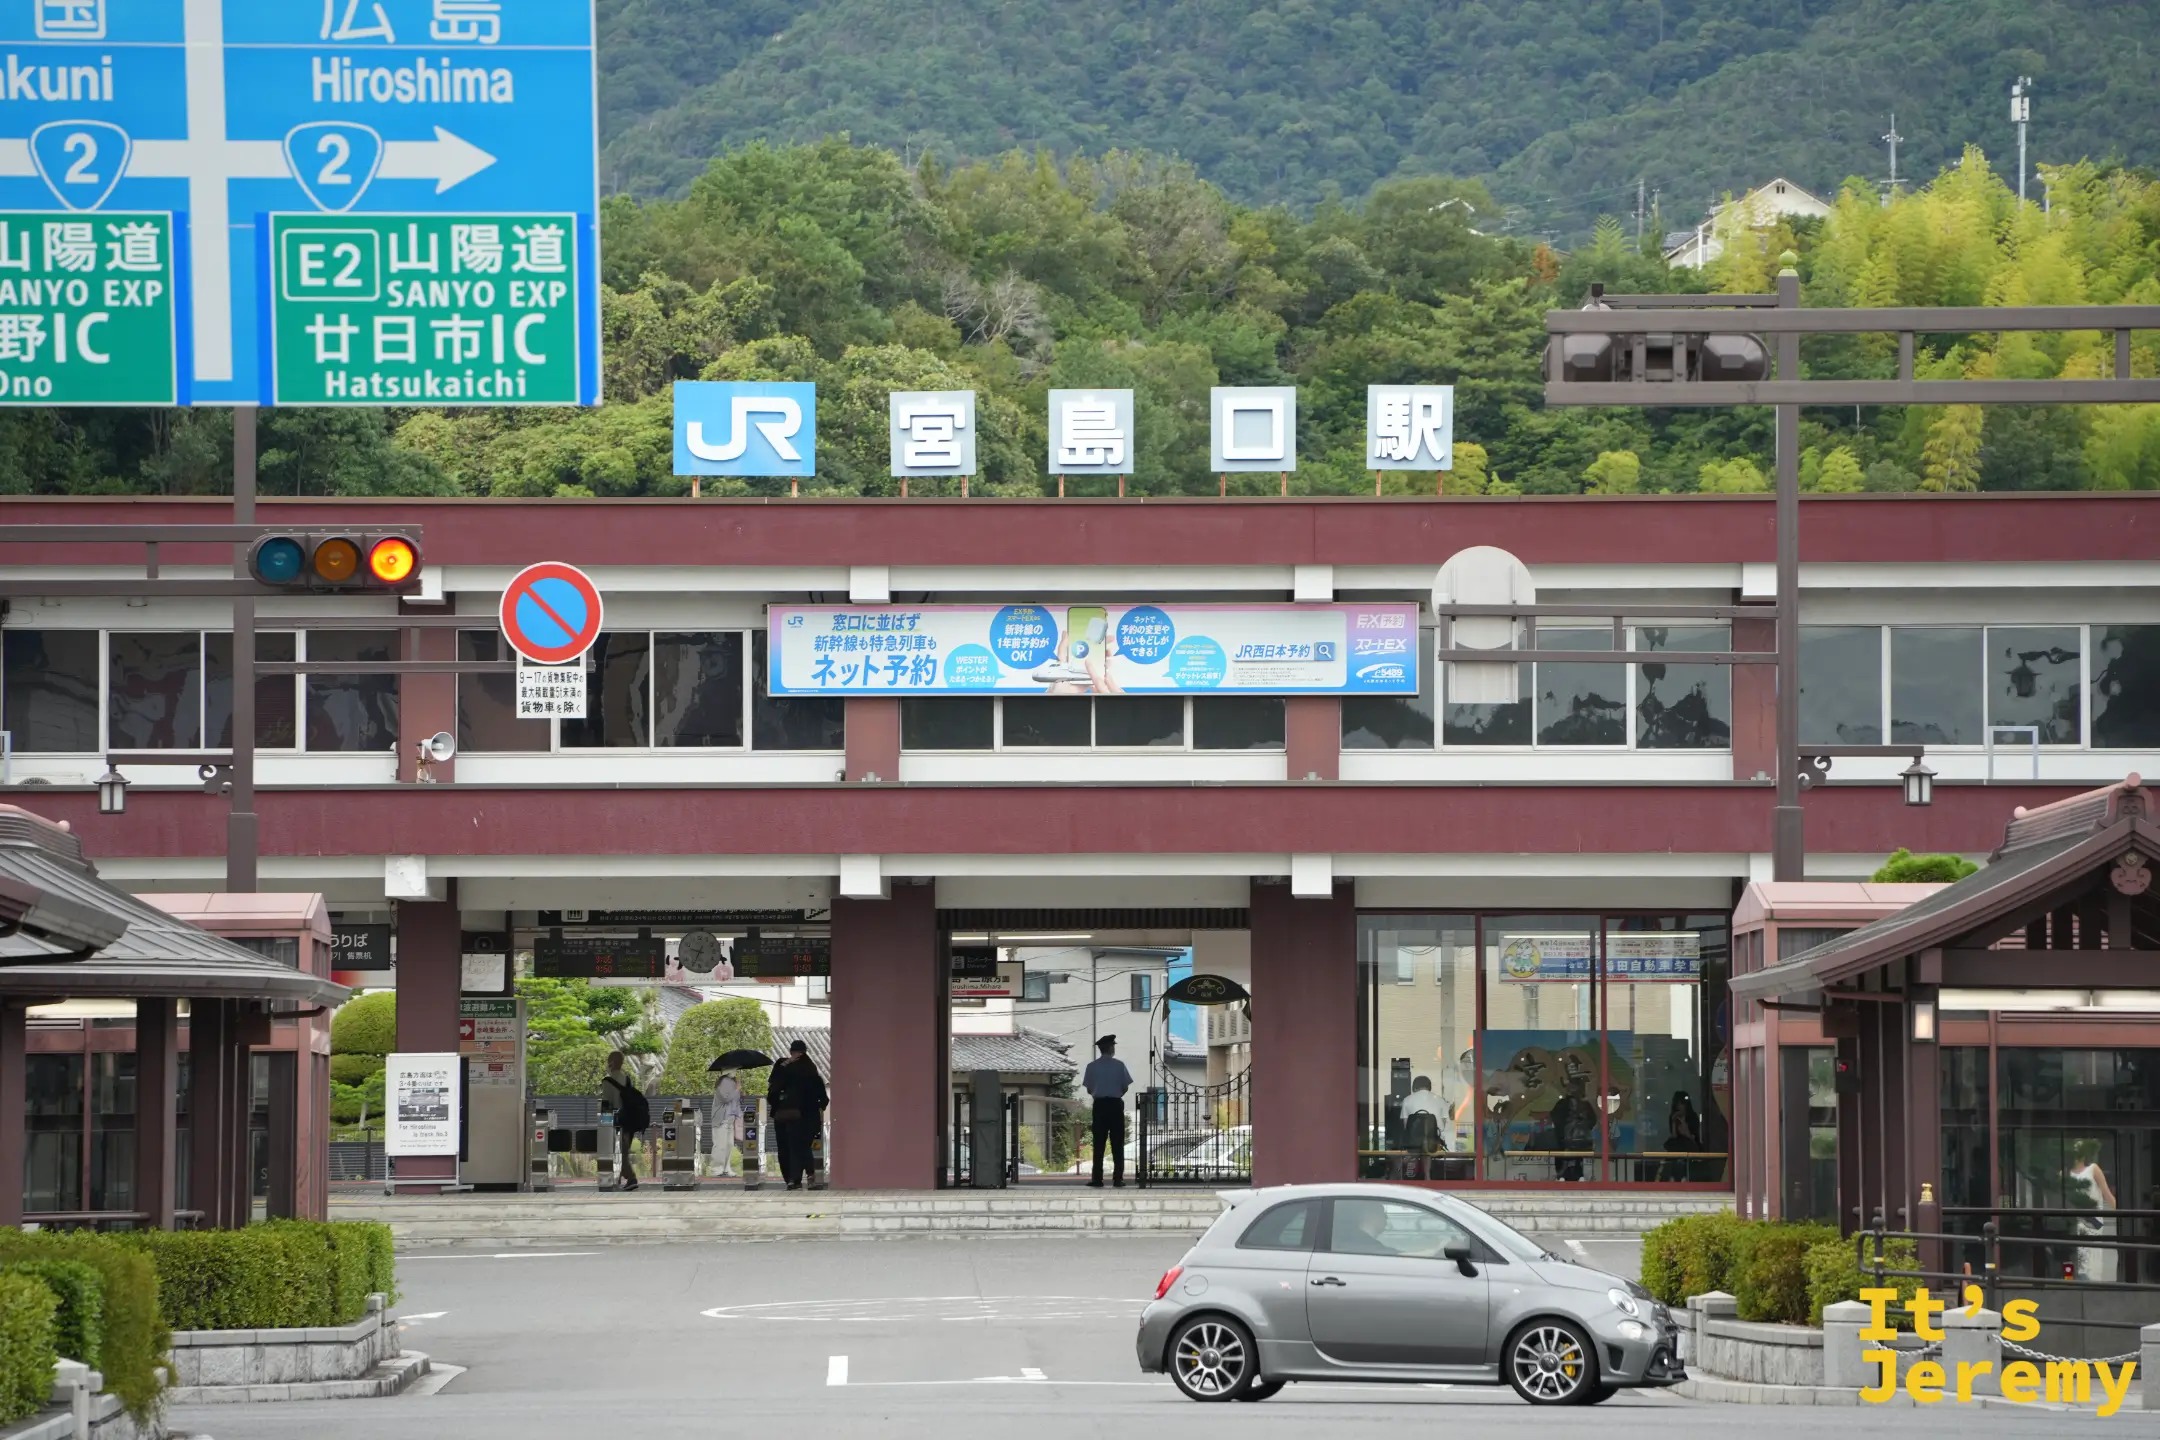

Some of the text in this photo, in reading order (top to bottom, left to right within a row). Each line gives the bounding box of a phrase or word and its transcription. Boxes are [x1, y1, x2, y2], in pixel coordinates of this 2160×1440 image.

[319, 0, 502, 44] 広島
[0, 54, 114, 102] kuni
[311, 56, 514, 103] Hiroshima
[64, 132, 99, 184] 2
[317, 133, 352, 185] 2
[0, 221, 163, 272] 山陽道
[388, 223, 568, 273] 山陽道
[299, 241, 363, 288] E2
[104, 279, 163, 307] EXP
[387, 280, 568, 308] SANYO EXP
[305, 313, 547, 365] 廿日市IC
[325, 369, 527, 398] Hatsukaichi
[686, 393, 1446, 468] JR 宮島口駅
[787, 616, 803, 626] JR
[832, 613, 921, 631] 窓口に並ばず
[1005, 624, 1044, 636] 新幹線の
[1121, 625, 1170, 635] 予約の変更や
[1134, 616, 1156, 624] ネットで
[1356, 613, 1406, 629] EX予約
[814, 635, 937, 653] 新幹線も特急列車も
[997, 637, 1050, 649] 1年前予約が
[1122, 636, 1169, 646] 払いもどしが
[1235, 644, 1310, 659] JR西日本予約
[1355, 638, 1408, 650] スマートEX
[811, 654, 938, 687] ネット予約
[955, 655, 989, 665] WESTER
[520, 700, 581, 714] 貨物車を除く
